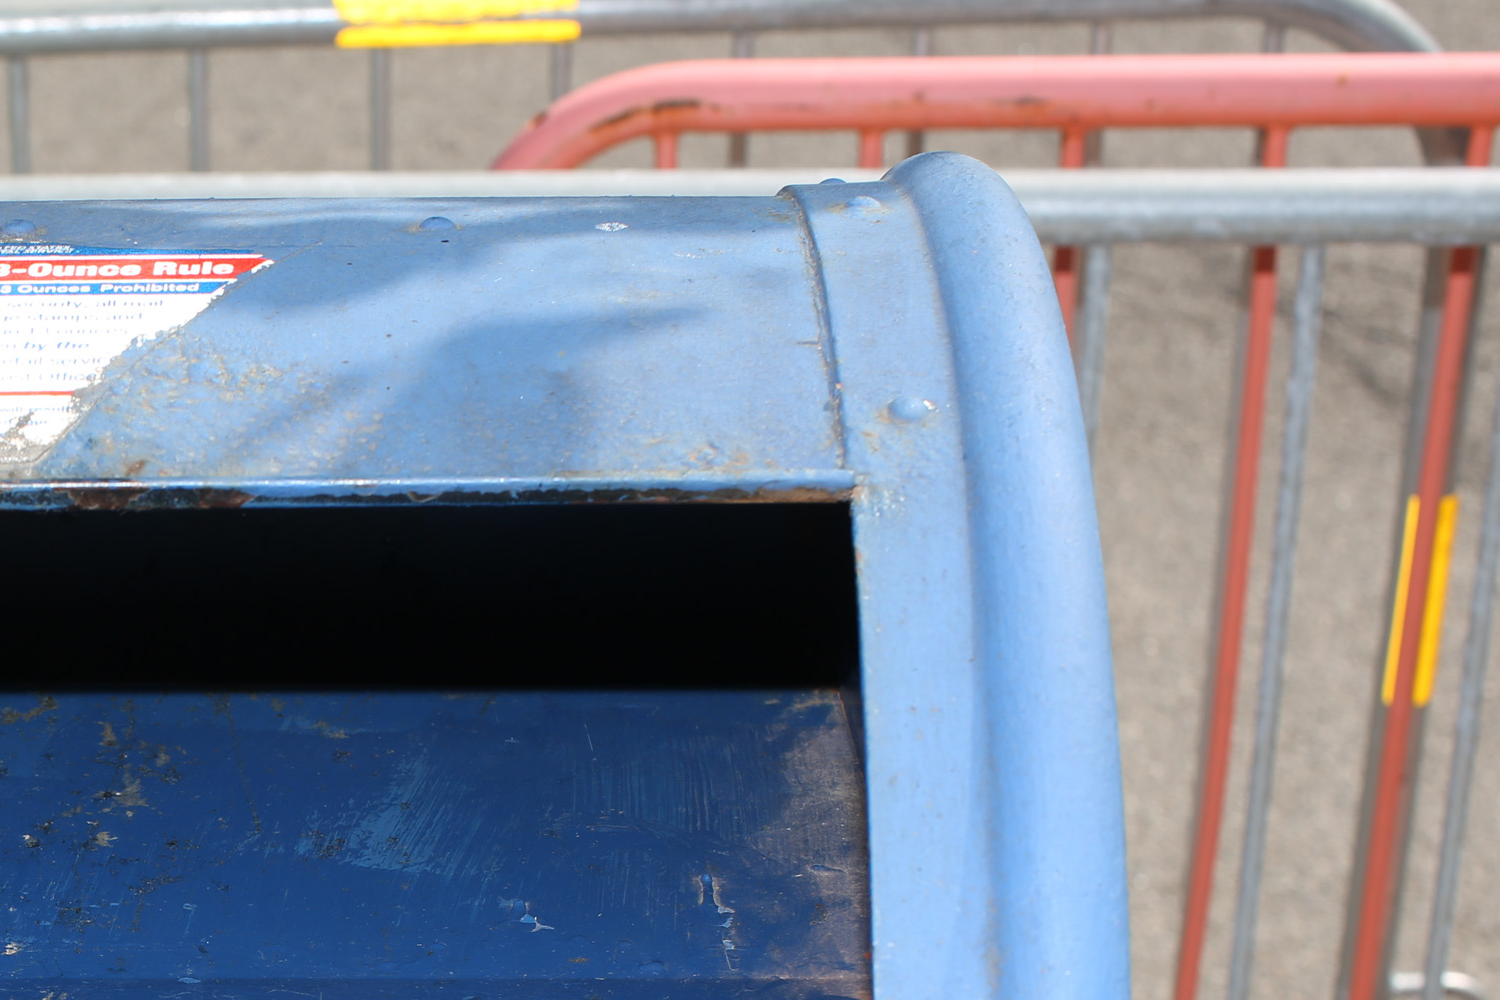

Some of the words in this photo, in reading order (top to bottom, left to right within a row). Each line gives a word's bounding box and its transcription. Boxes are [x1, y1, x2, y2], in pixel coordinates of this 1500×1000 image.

[153, 261, 234, 276] Rule
[17, 284, 91, 294] Ounces
[99, 283, 200, 294] Prohibited
[124, 299, 164, 307] mail
[24, 341, 48, 351] by
[57, 341, 90, 349] the
